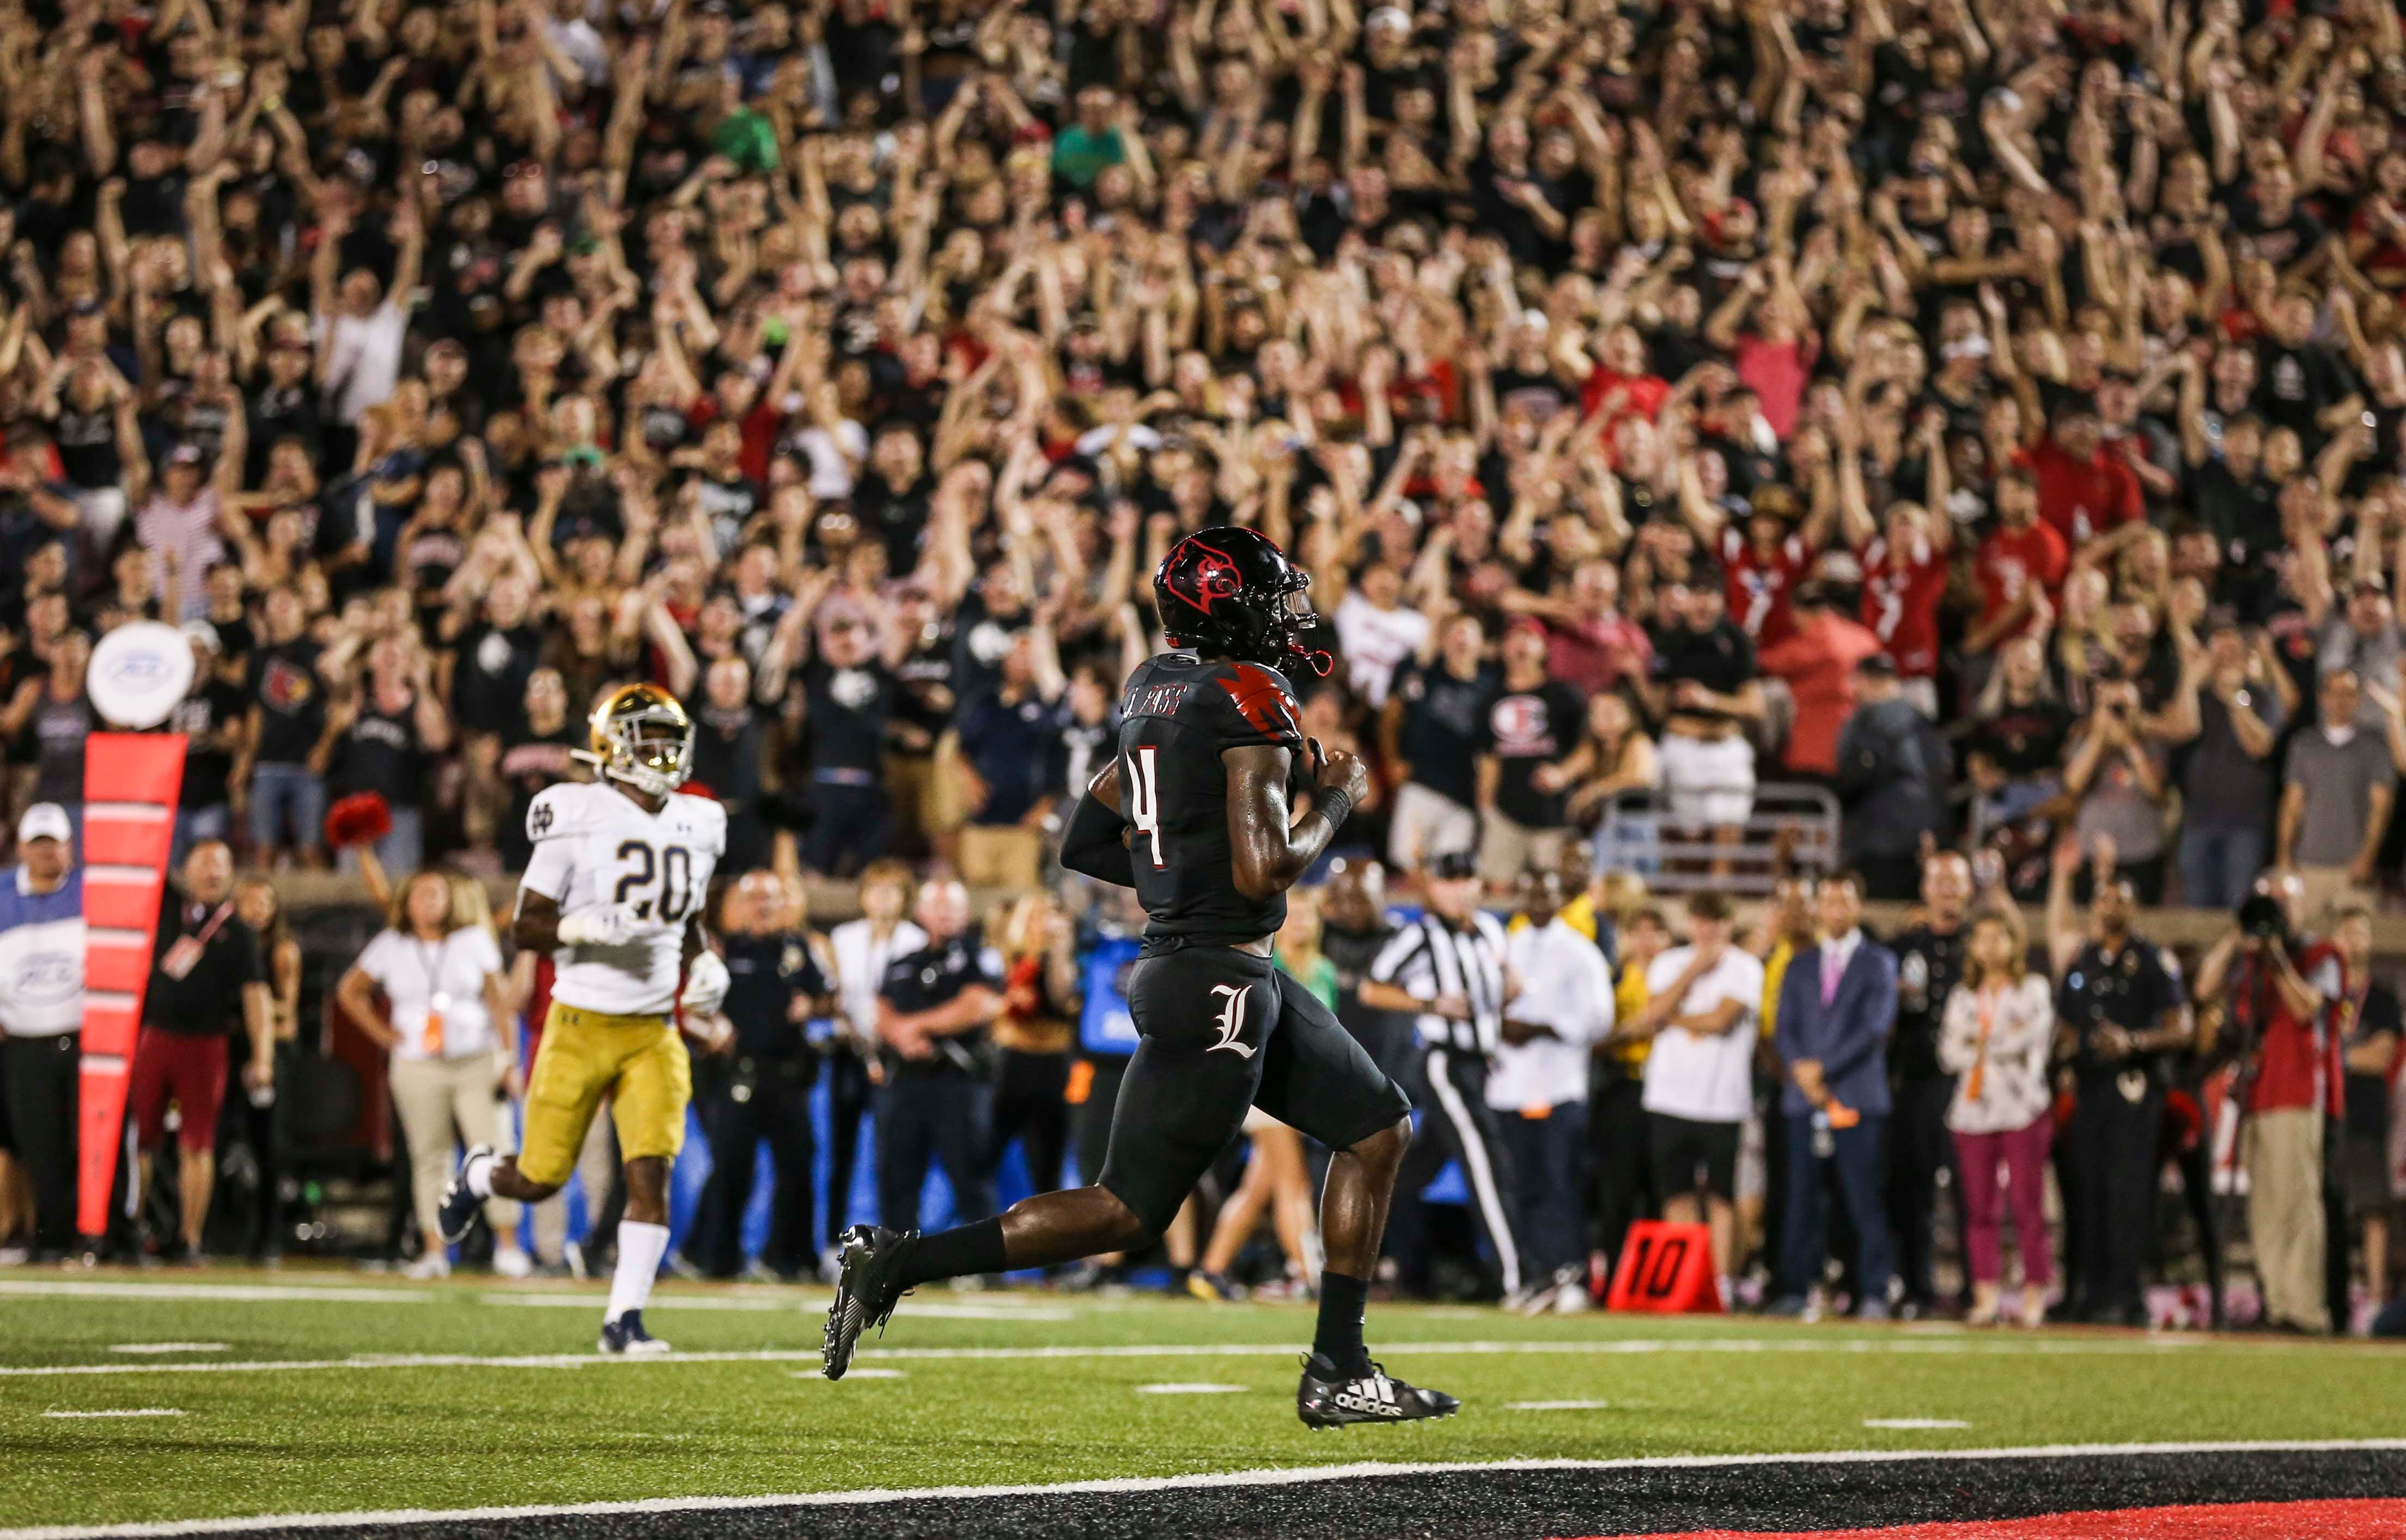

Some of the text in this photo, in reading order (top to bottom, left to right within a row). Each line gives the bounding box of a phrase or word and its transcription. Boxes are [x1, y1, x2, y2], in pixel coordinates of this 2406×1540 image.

[1124, 745, 1165, 868] 4
[614, 839, 692, 924] 20
[1205, 982, 1258, 1059] L
[1629, 1238, 1688, 1298] 10
[1335, 1392, 1404, 1416] adidas
